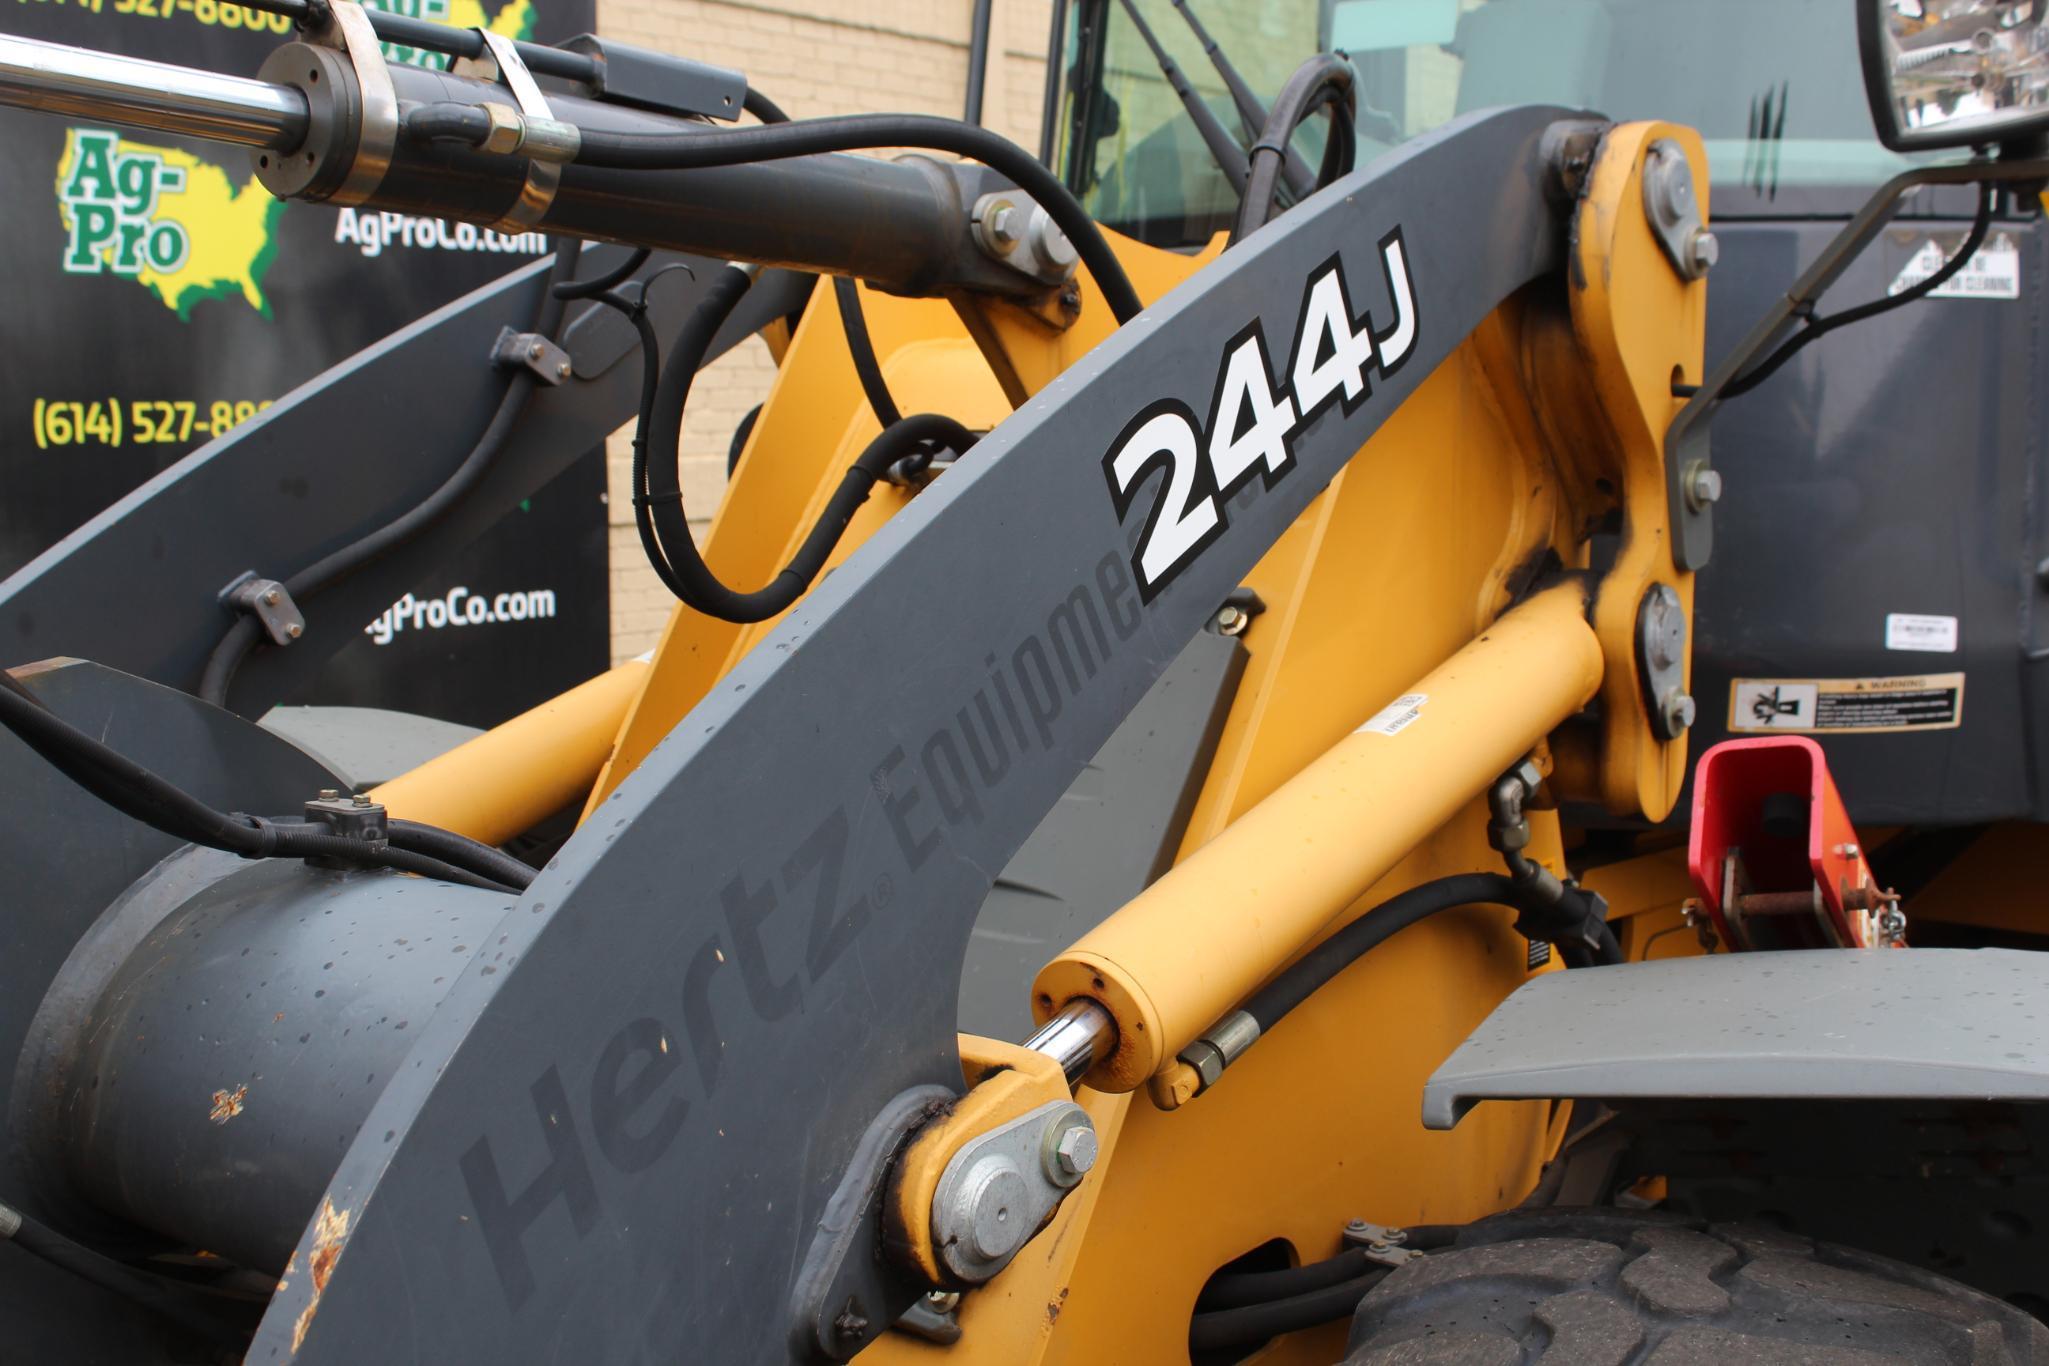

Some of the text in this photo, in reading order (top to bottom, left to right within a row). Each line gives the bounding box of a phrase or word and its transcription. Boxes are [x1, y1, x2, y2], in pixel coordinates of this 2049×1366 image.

[65, 128, 187, 203] Ag-
[64, 203, 189, 274] Pro
[334, 207, 547, 257] AgProCo.com
[33, 398, 122, 450] (614)
[1102, 224, 1420, 606] 244J
[1871, 679, 1927, 690] WARNING
[459, 803, 871, 1313] Hertz
